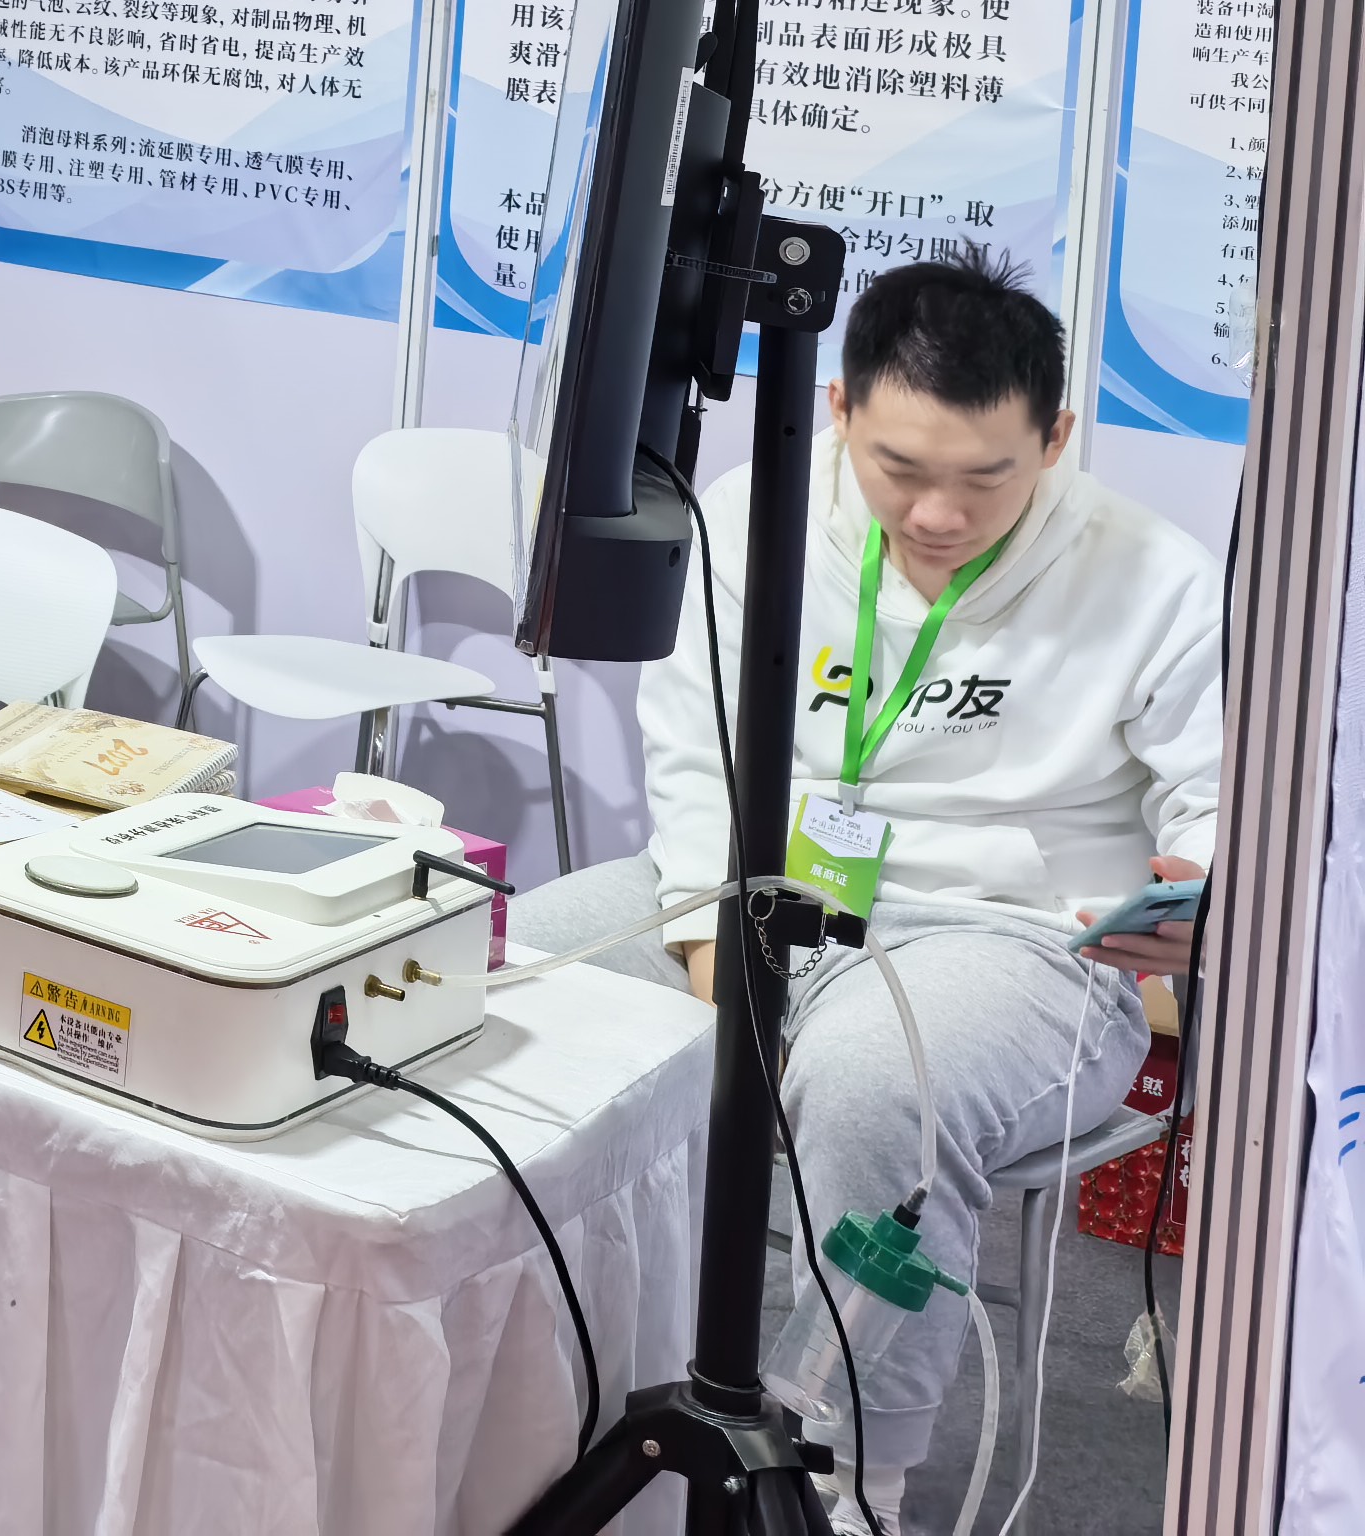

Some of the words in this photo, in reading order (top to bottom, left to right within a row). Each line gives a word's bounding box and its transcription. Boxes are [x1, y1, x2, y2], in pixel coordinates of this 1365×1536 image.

[1194, 22, 1272, 43] 造和使用
[508, 40, 569, 68] 爽滑
[1192, 47, 1269, 66] 响生产车
[1231, 72, 1268, 90] 我公
[1189, 92, 1266, 114] 可供不同
[497, 187, 548, 216] 本品
[1222, 215, 1258, 233] 添加
[896, 722, 925, 734] YOU
[942, 724, 973, 734] YOU
[978, 721, 998, 731] UP
[810, 863, 848, 887] 展商证
[47, 983, 79, 1010] 警告
